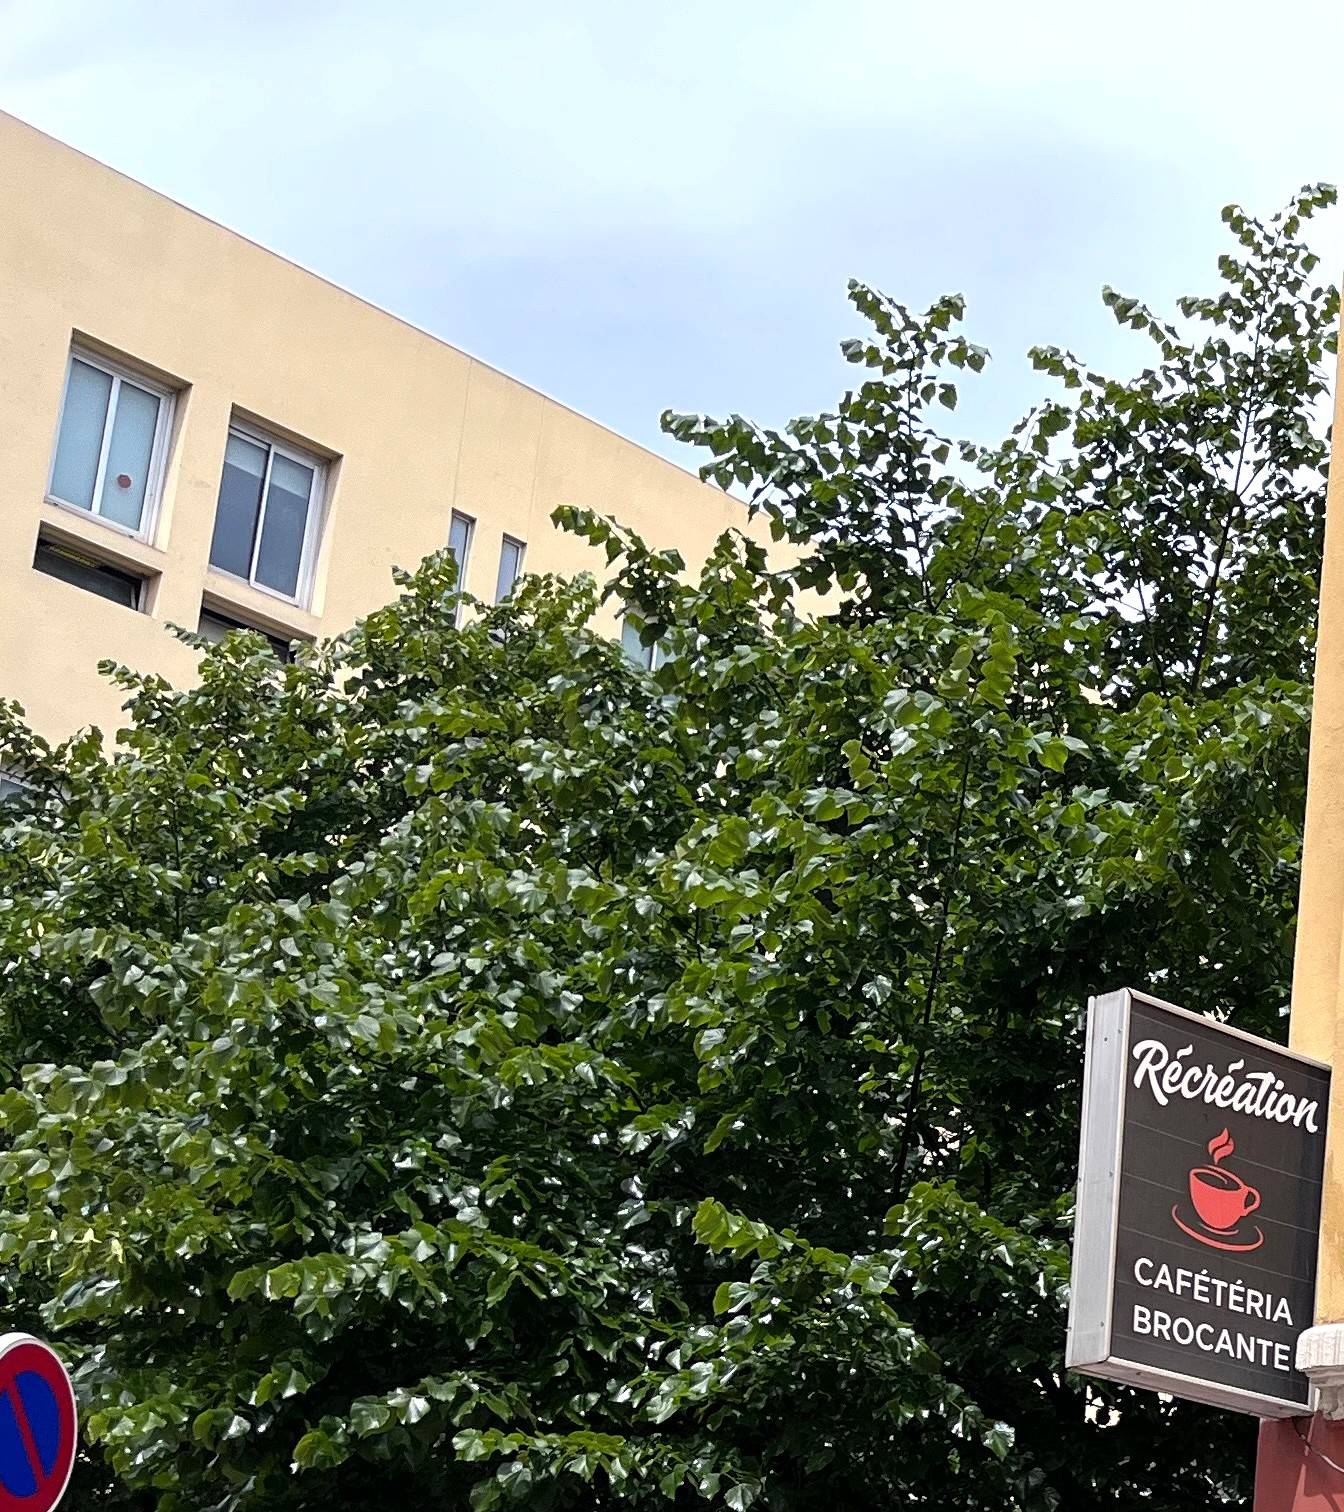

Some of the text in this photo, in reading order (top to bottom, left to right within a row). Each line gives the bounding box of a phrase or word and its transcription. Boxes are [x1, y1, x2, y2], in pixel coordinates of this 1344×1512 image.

[1132, 1038, 1319, 1133] Récréation
[1133, 1257, 1293, 1326] CAFÉTÉRIA
[1132, 1304, 1291, 1372] BROCANTE
